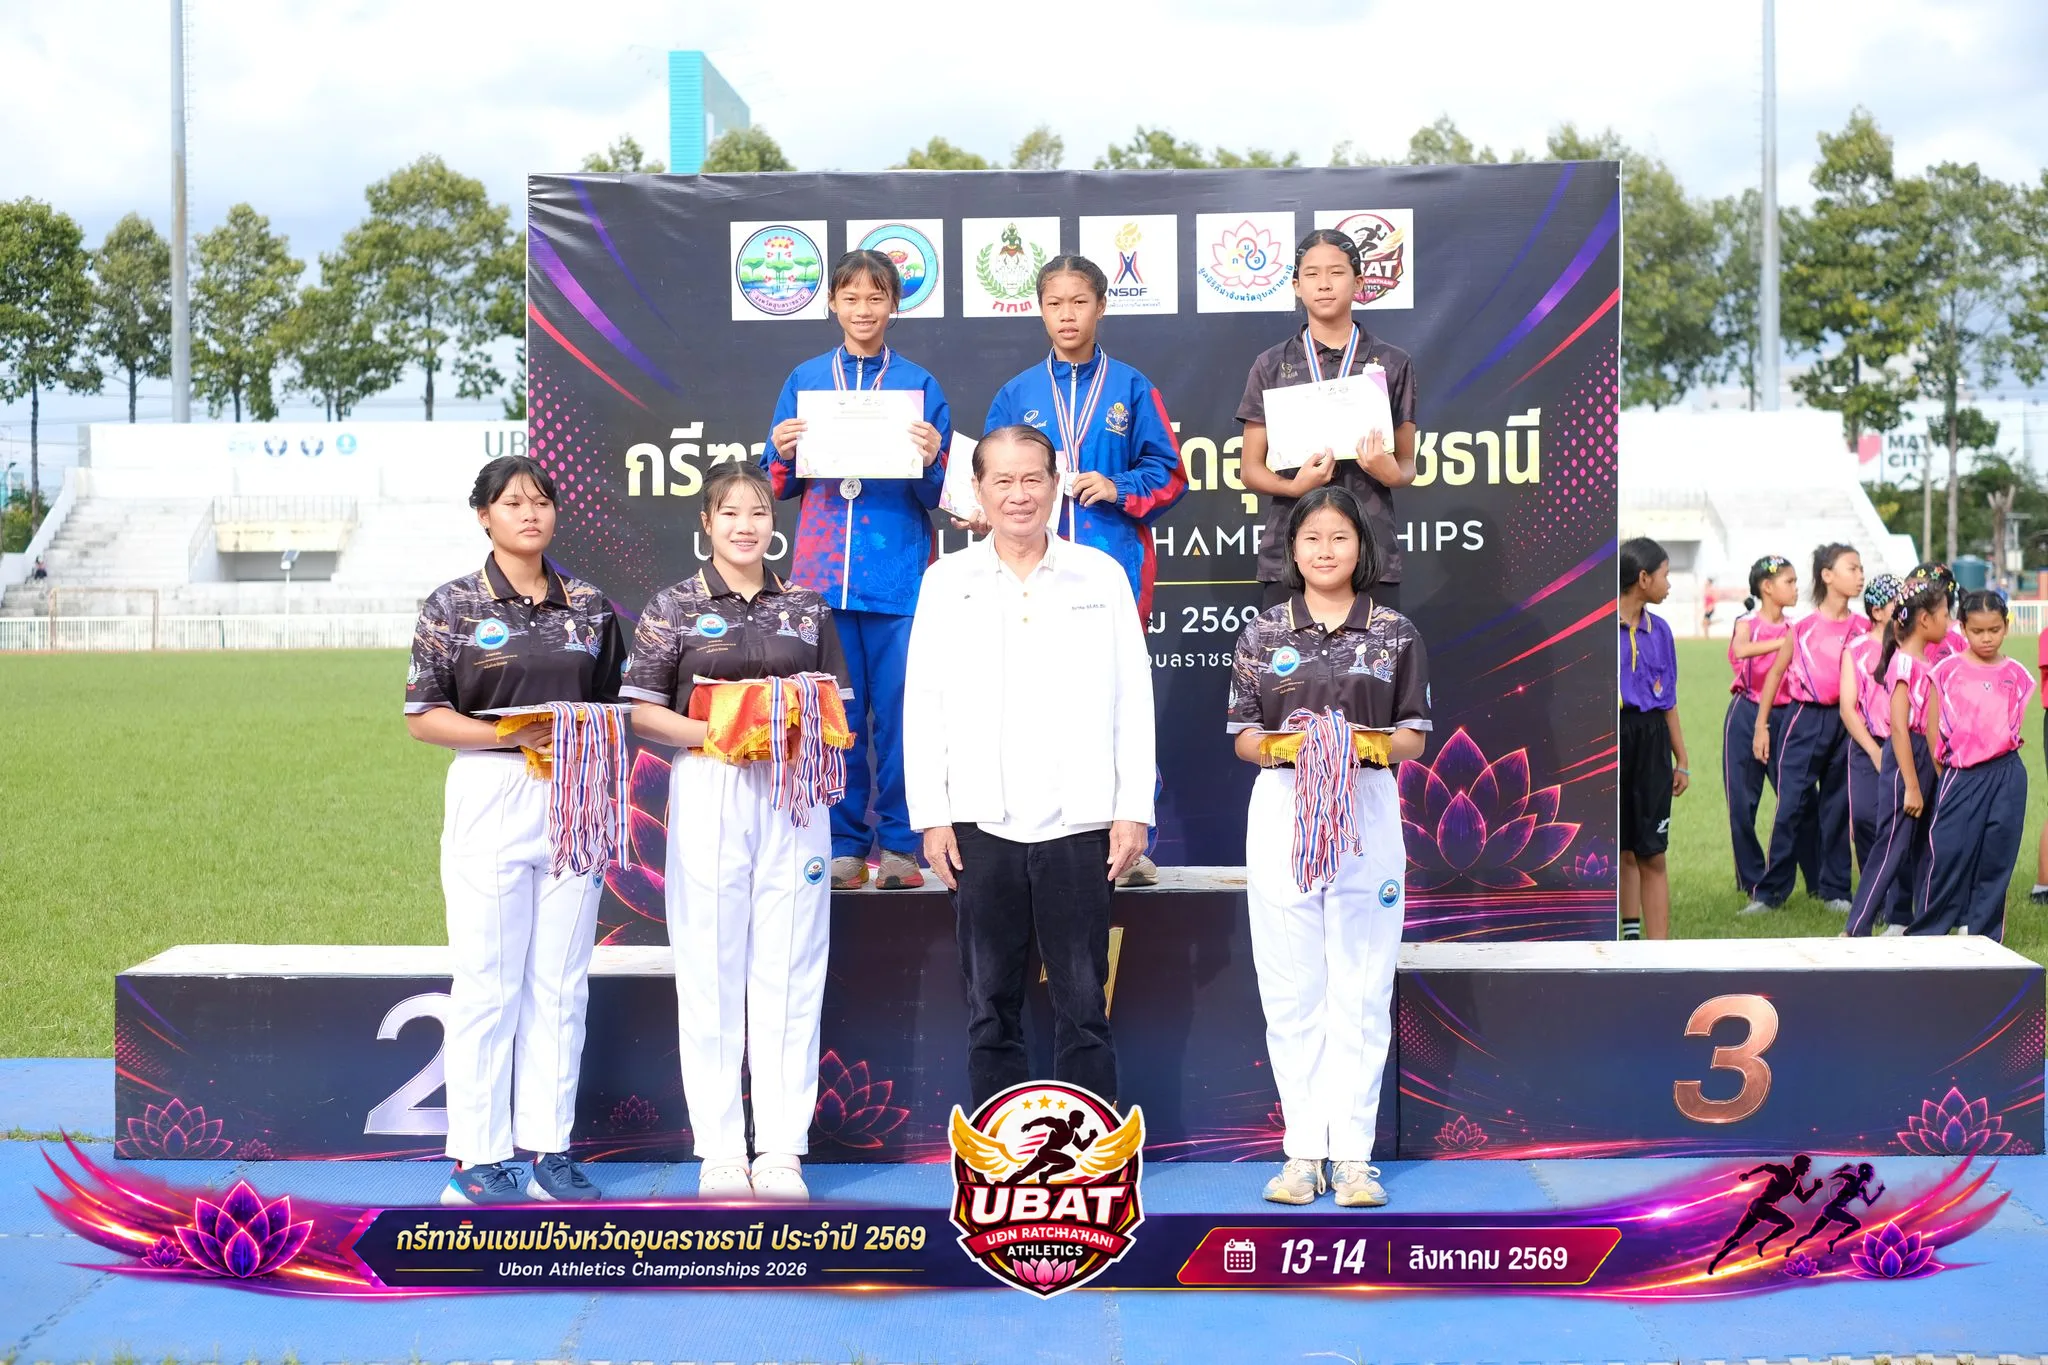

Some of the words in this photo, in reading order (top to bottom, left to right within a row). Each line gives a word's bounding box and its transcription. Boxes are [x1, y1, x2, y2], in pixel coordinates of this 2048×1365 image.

[1108, 287, 1148, 297] NSDF
[992, 301, 1032, 313] กกท
[1673, 994, 1780, 1123] 3
